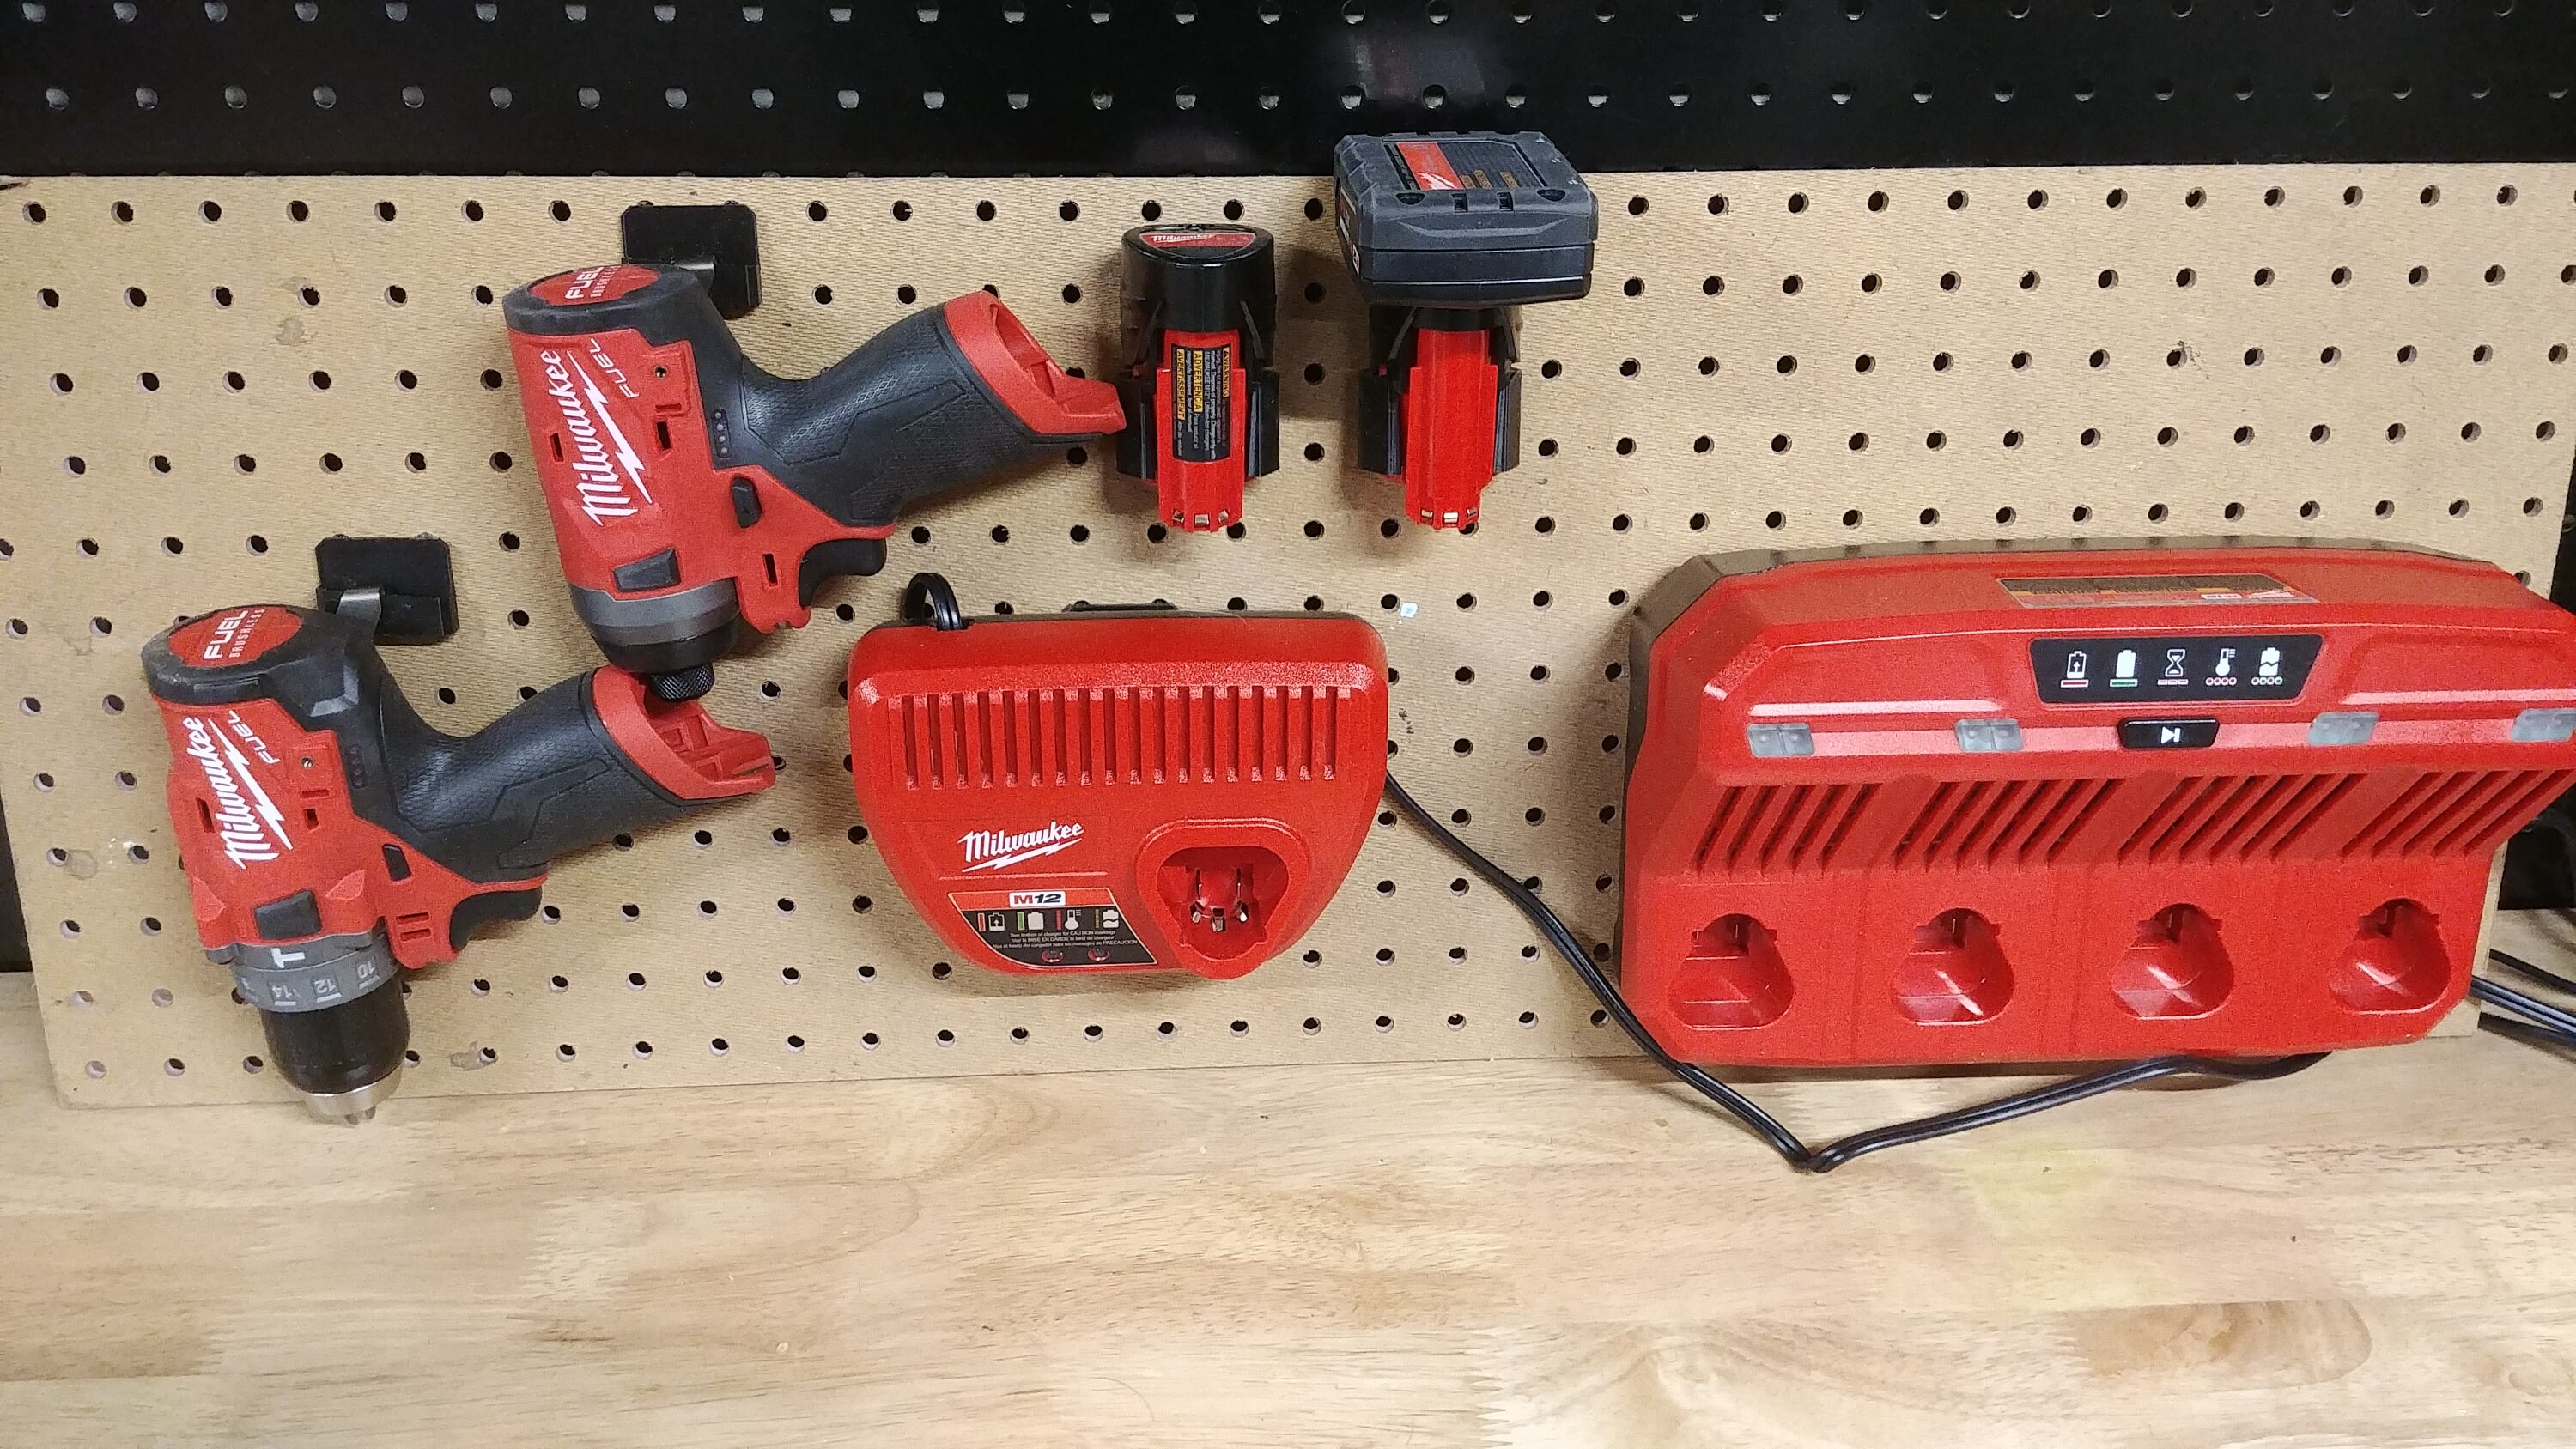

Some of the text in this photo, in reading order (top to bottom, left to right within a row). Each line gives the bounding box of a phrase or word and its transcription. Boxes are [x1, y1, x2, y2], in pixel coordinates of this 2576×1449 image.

[565, 266, 605, 299] FUEL
[590, 337, 640, 398] FUEL
[539, 349, 638, 526] Milwaukee
[204, 610, 248, 659] FUEL
[227, 710, 280, 765] FUEL
[182, 717, 279, 870] Milwaukee
[957, 821, 1084, 863] Milwaukee
[1013, 894, 1061, 905] M12
[313, 977, 338, 994] 12
[356, 958, 377, 979] 10
[270, 985, 293, 999] 14
